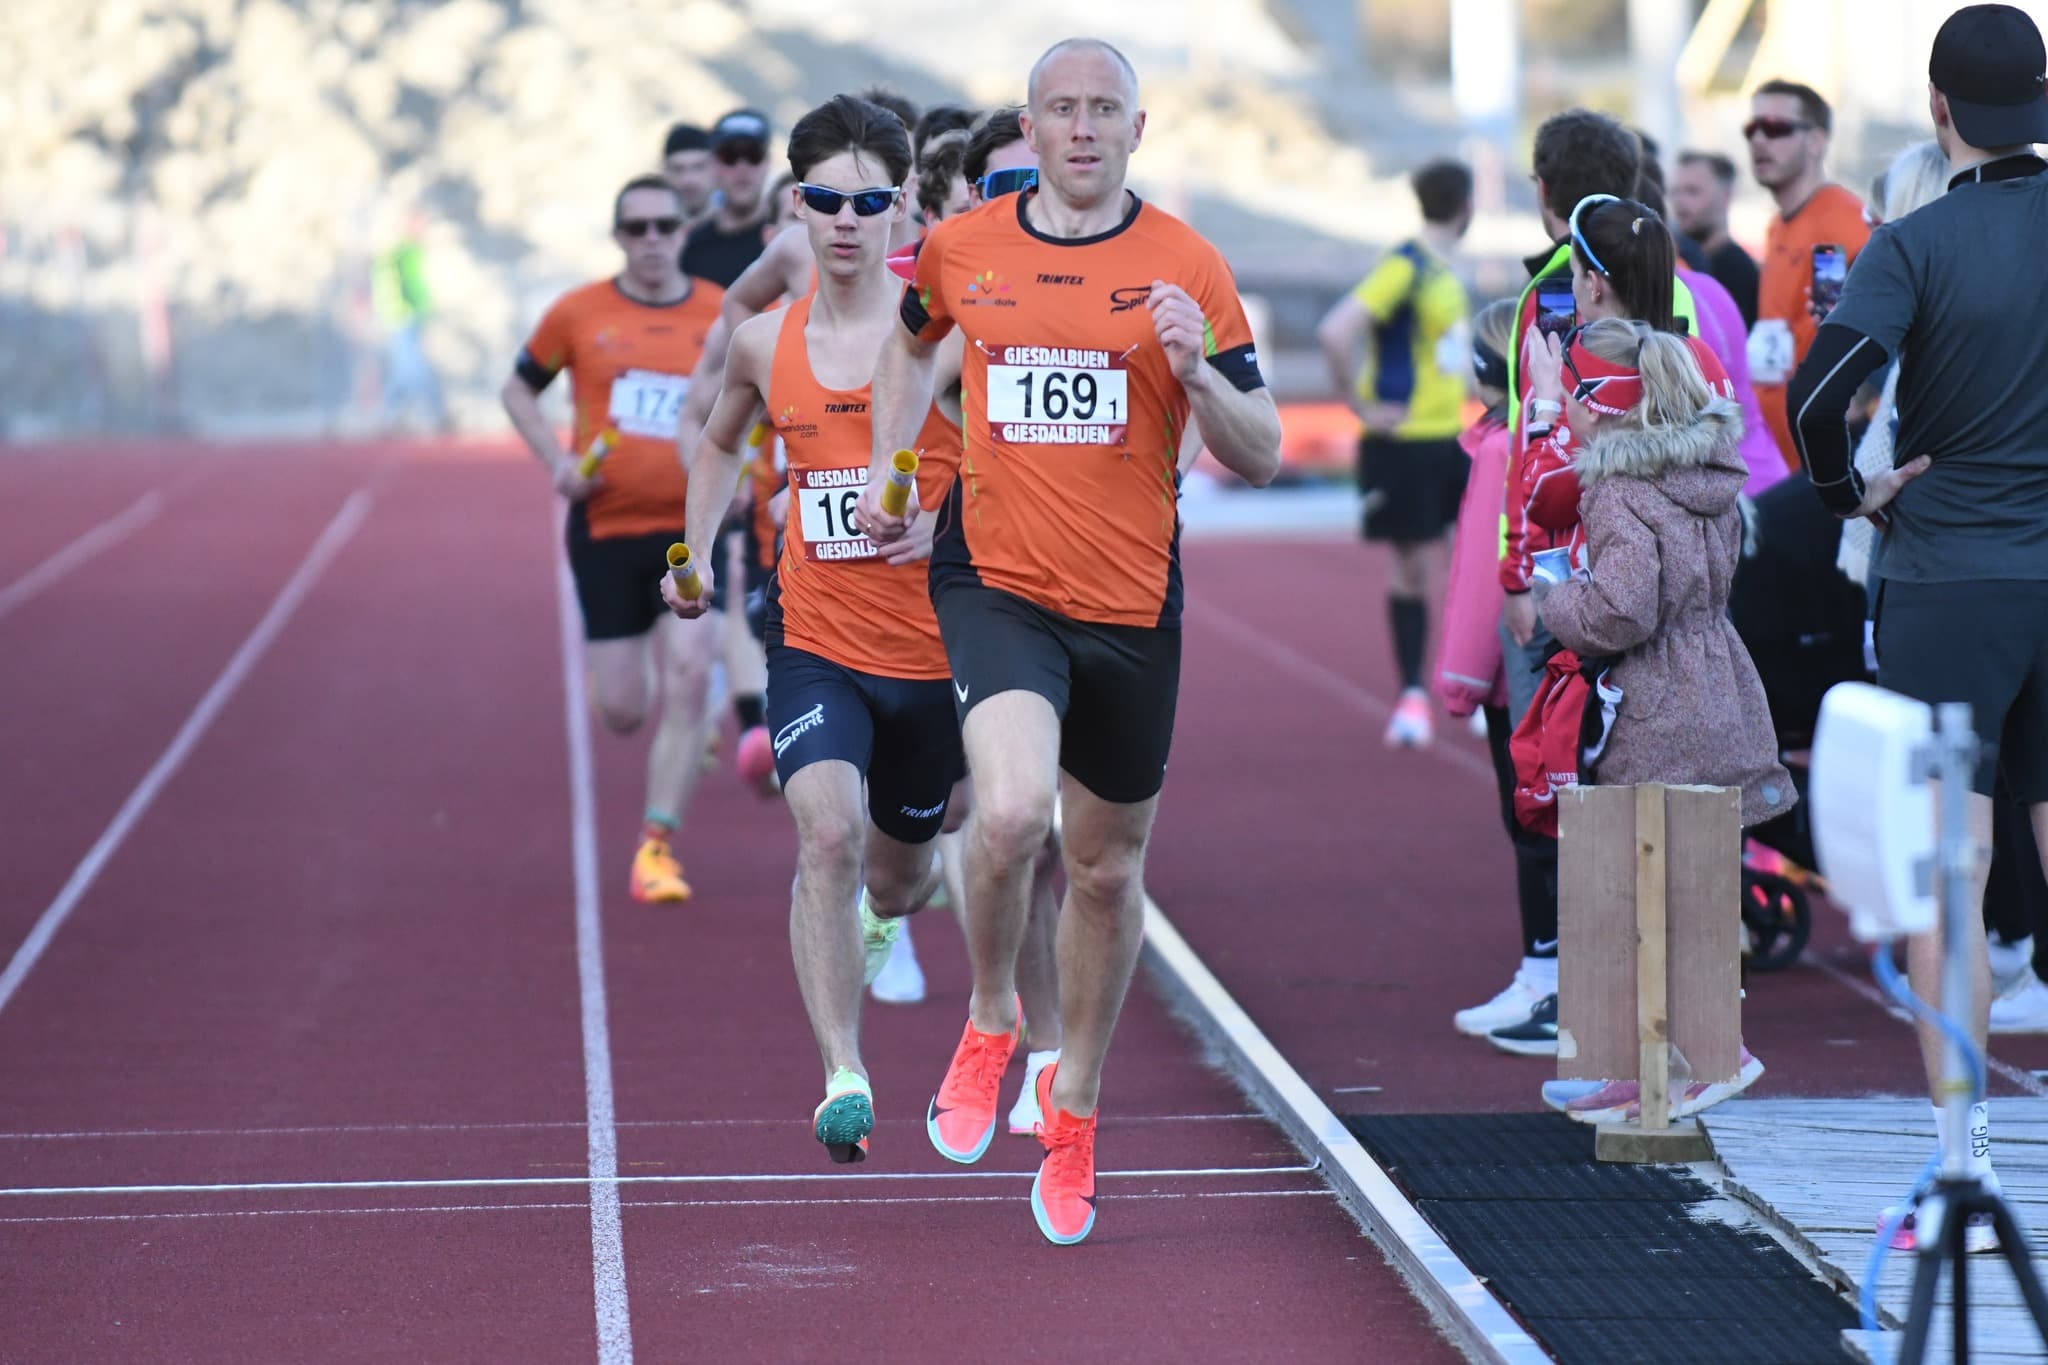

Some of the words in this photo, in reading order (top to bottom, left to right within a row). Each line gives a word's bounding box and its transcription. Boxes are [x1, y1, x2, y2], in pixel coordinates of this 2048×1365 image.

[1036, 274, 1085, 285] TRIMTEX
[1004, 347, 1109, 369] GJESDALBUEN
[1015, 371, 1098, 421] 169
[1108, 398, 1118, 420] 1
[825, 404, 866, 413] TRIMTEX
[1002, 424, 1109, 444] GJESDALBUEN
[774, 703, 825, 759] Spirit
